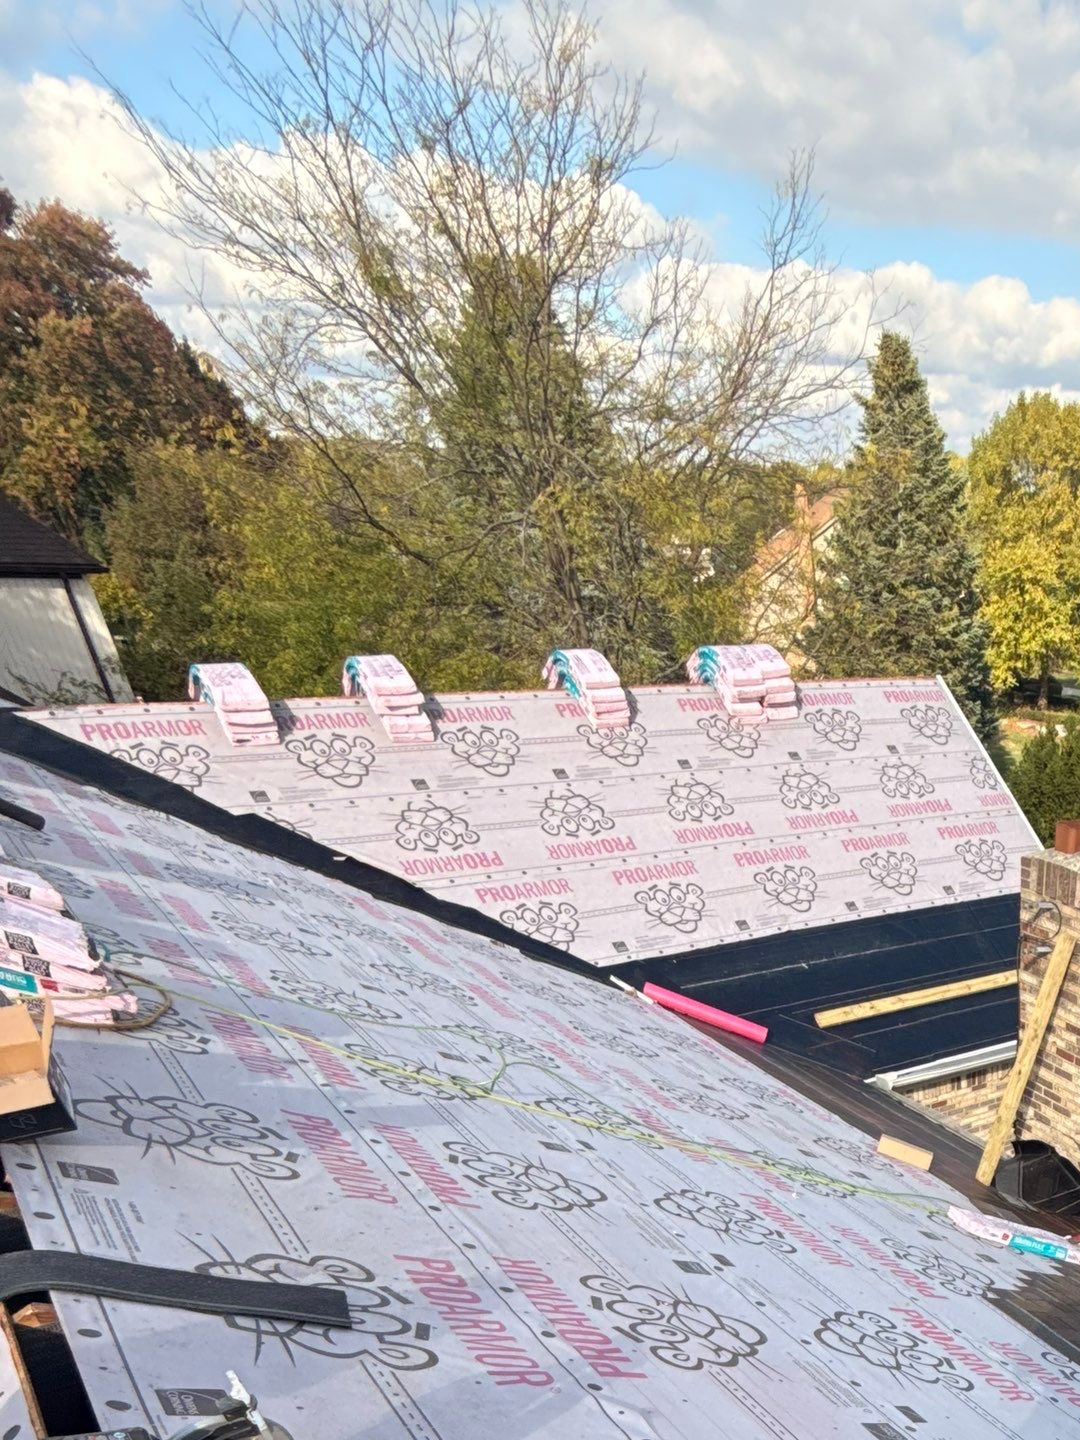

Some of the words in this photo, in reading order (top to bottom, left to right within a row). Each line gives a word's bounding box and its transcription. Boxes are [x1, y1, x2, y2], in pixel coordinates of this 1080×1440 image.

[800, 692, 856, 707] OARMOR
[883, 690, 946, 704] PROARMOR
[80, 718, 207, 742] PROARMOR
[278, 711, 371, 732] ROARMOR
[786, 809, 860, 830] PROARMOR
[887, 798, 954, 818] PROARMOR
[672, 821, 756, 845] PROARMOR
[841, 832, 911, 852] PROARMOR
[936, 821, 1000, 841] PROARMOR
[545, 836, 638, 860] PROARMOR
[733, 845, 811, 867] PROARMOR
[399, 850, 505, 877] PROARMOR
[612, 860, 699, 886] PROARMOR
[474, 878, 574, 904] PROARMOR
[393, 1254, 556, 1386] PROARMOR
[491, 1255, 648, 1379] PROARMOR
[889, 1307, 1035, 1402] PROARMOR
